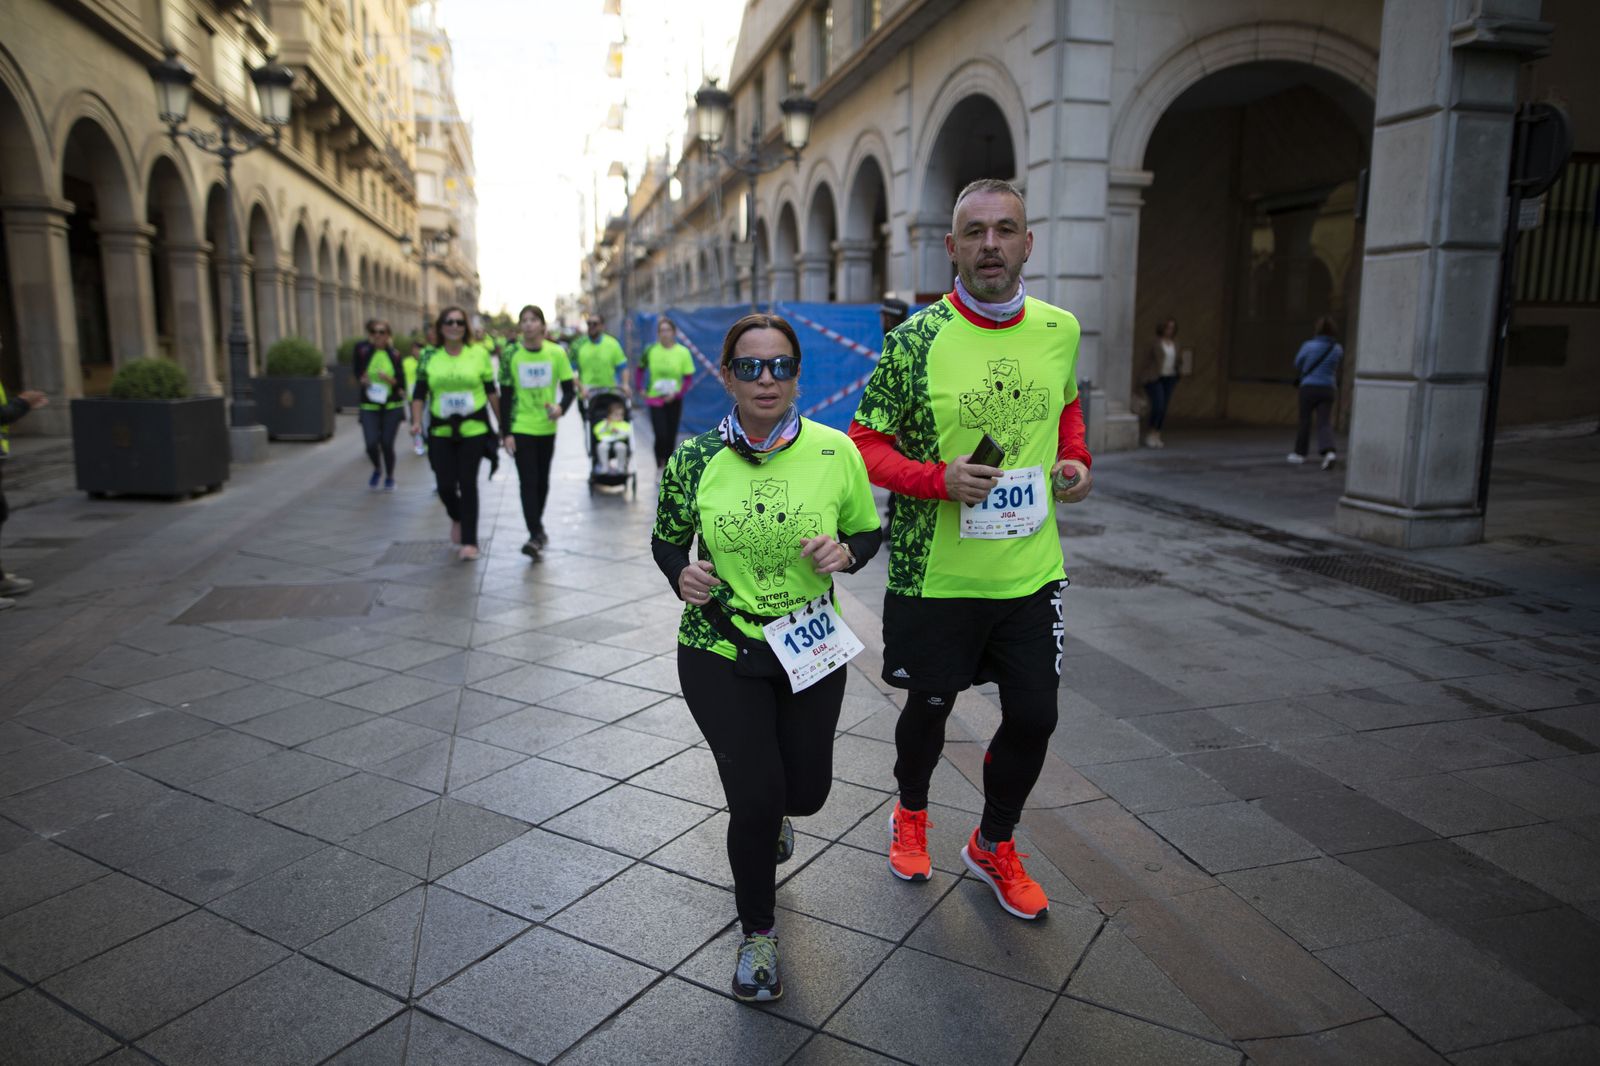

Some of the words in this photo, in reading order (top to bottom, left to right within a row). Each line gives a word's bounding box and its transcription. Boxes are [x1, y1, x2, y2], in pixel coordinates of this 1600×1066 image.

[1000, 511, 1017, 519] JIGA
[755, 591, 789, 602] carrera
[784, 612, 835, 654] 1302
[812, 643, 828, 656] ELISA
